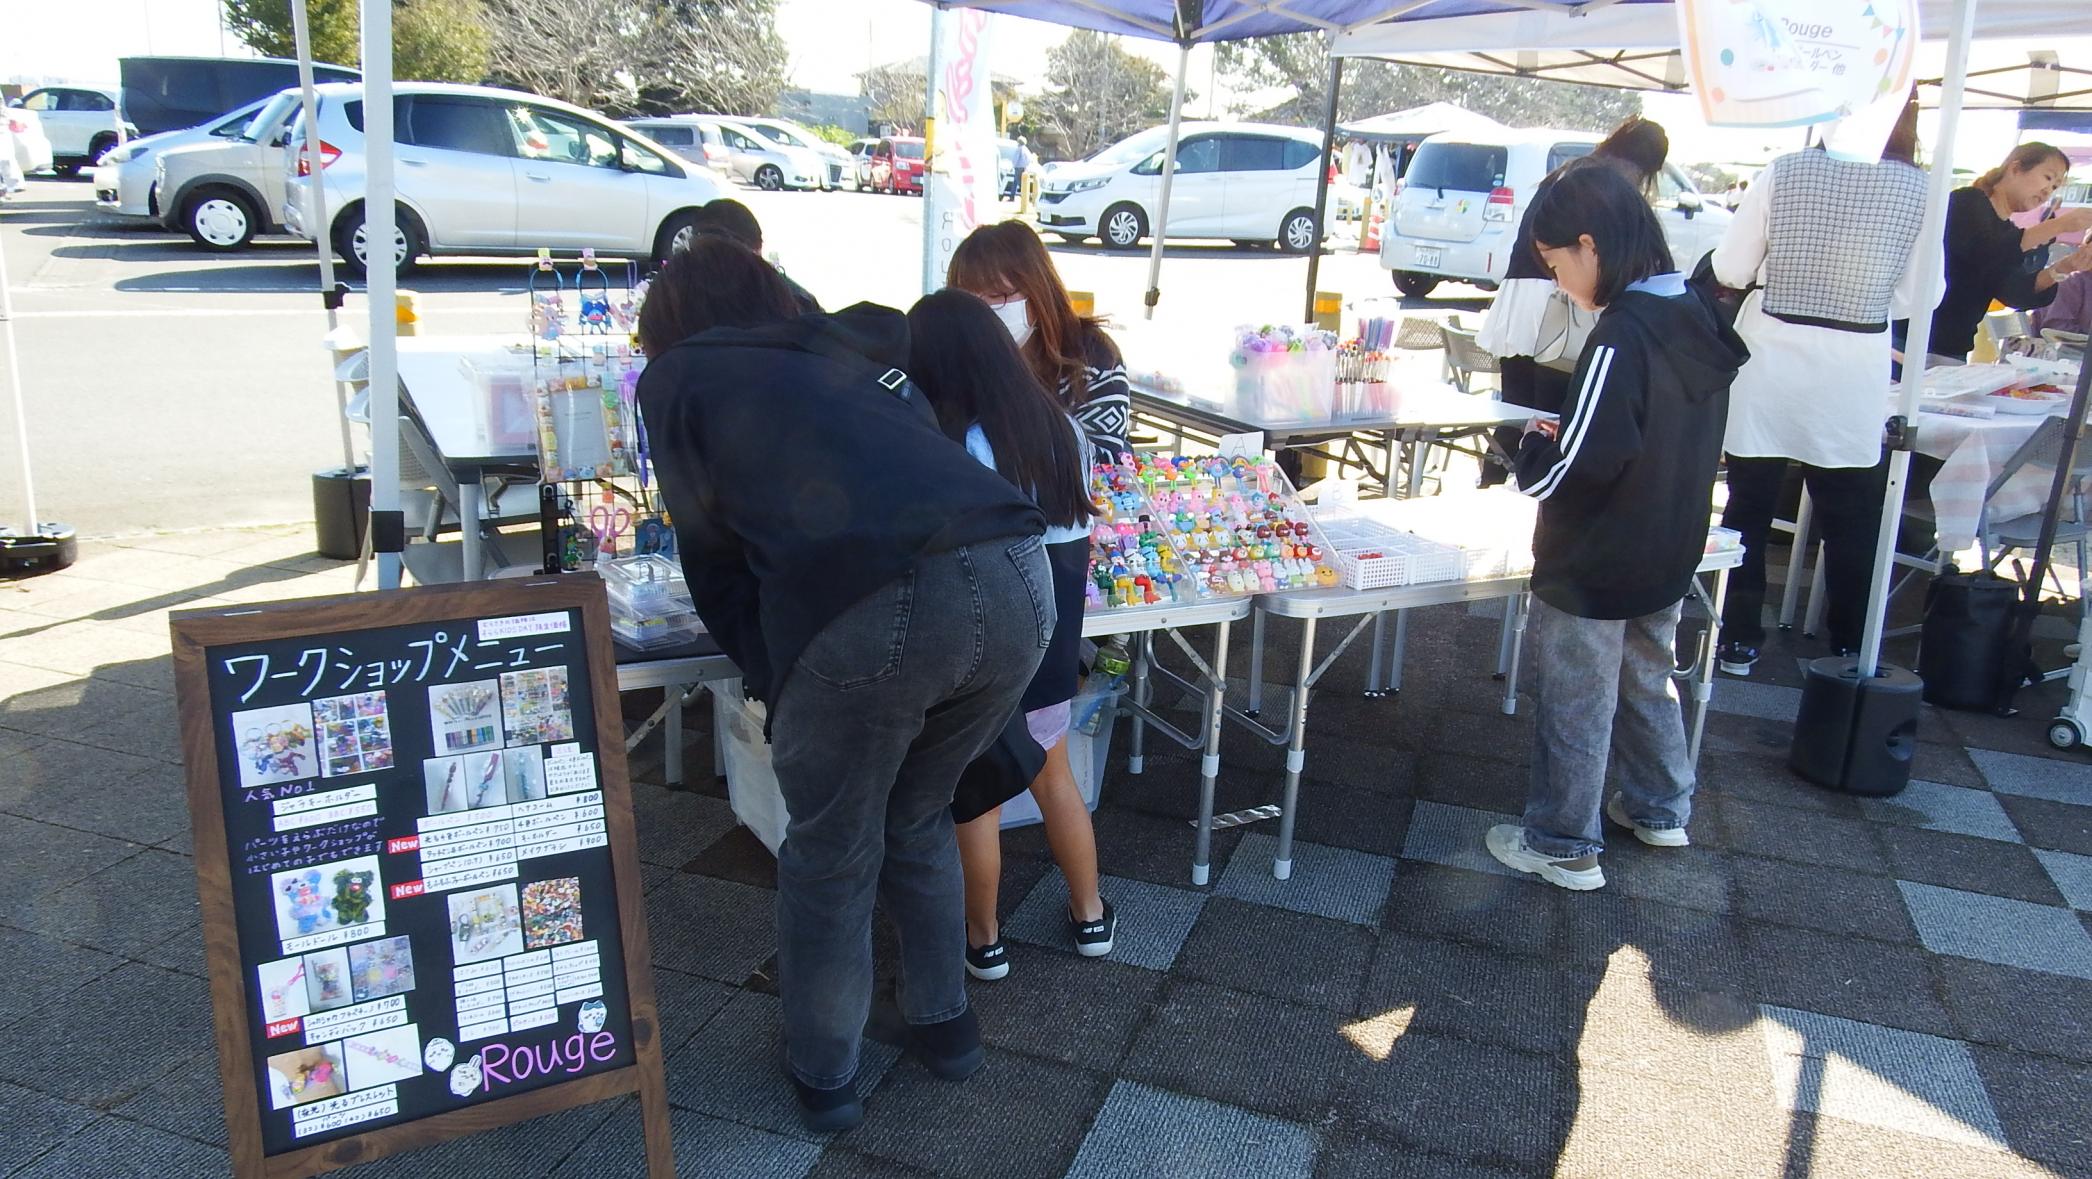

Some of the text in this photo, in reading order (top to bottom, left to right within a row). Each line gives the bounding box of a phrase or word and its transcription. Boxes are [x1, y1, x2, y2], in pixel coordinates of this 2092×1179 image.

[1799, 46, 1844, 61] ールペン
[1230, 436, 1247, 456] A
[224, 631, 565, 704] ワークショップメニュー
[244, 787, 275, 803] 人気
[390, 839, 419, 852] New
[395, 883, 424, 898] New
[343, 926, 370, 940] ¥800
[268, 1019, 299, 1036] New
[481, 1031, 617, 1092] Rouge
